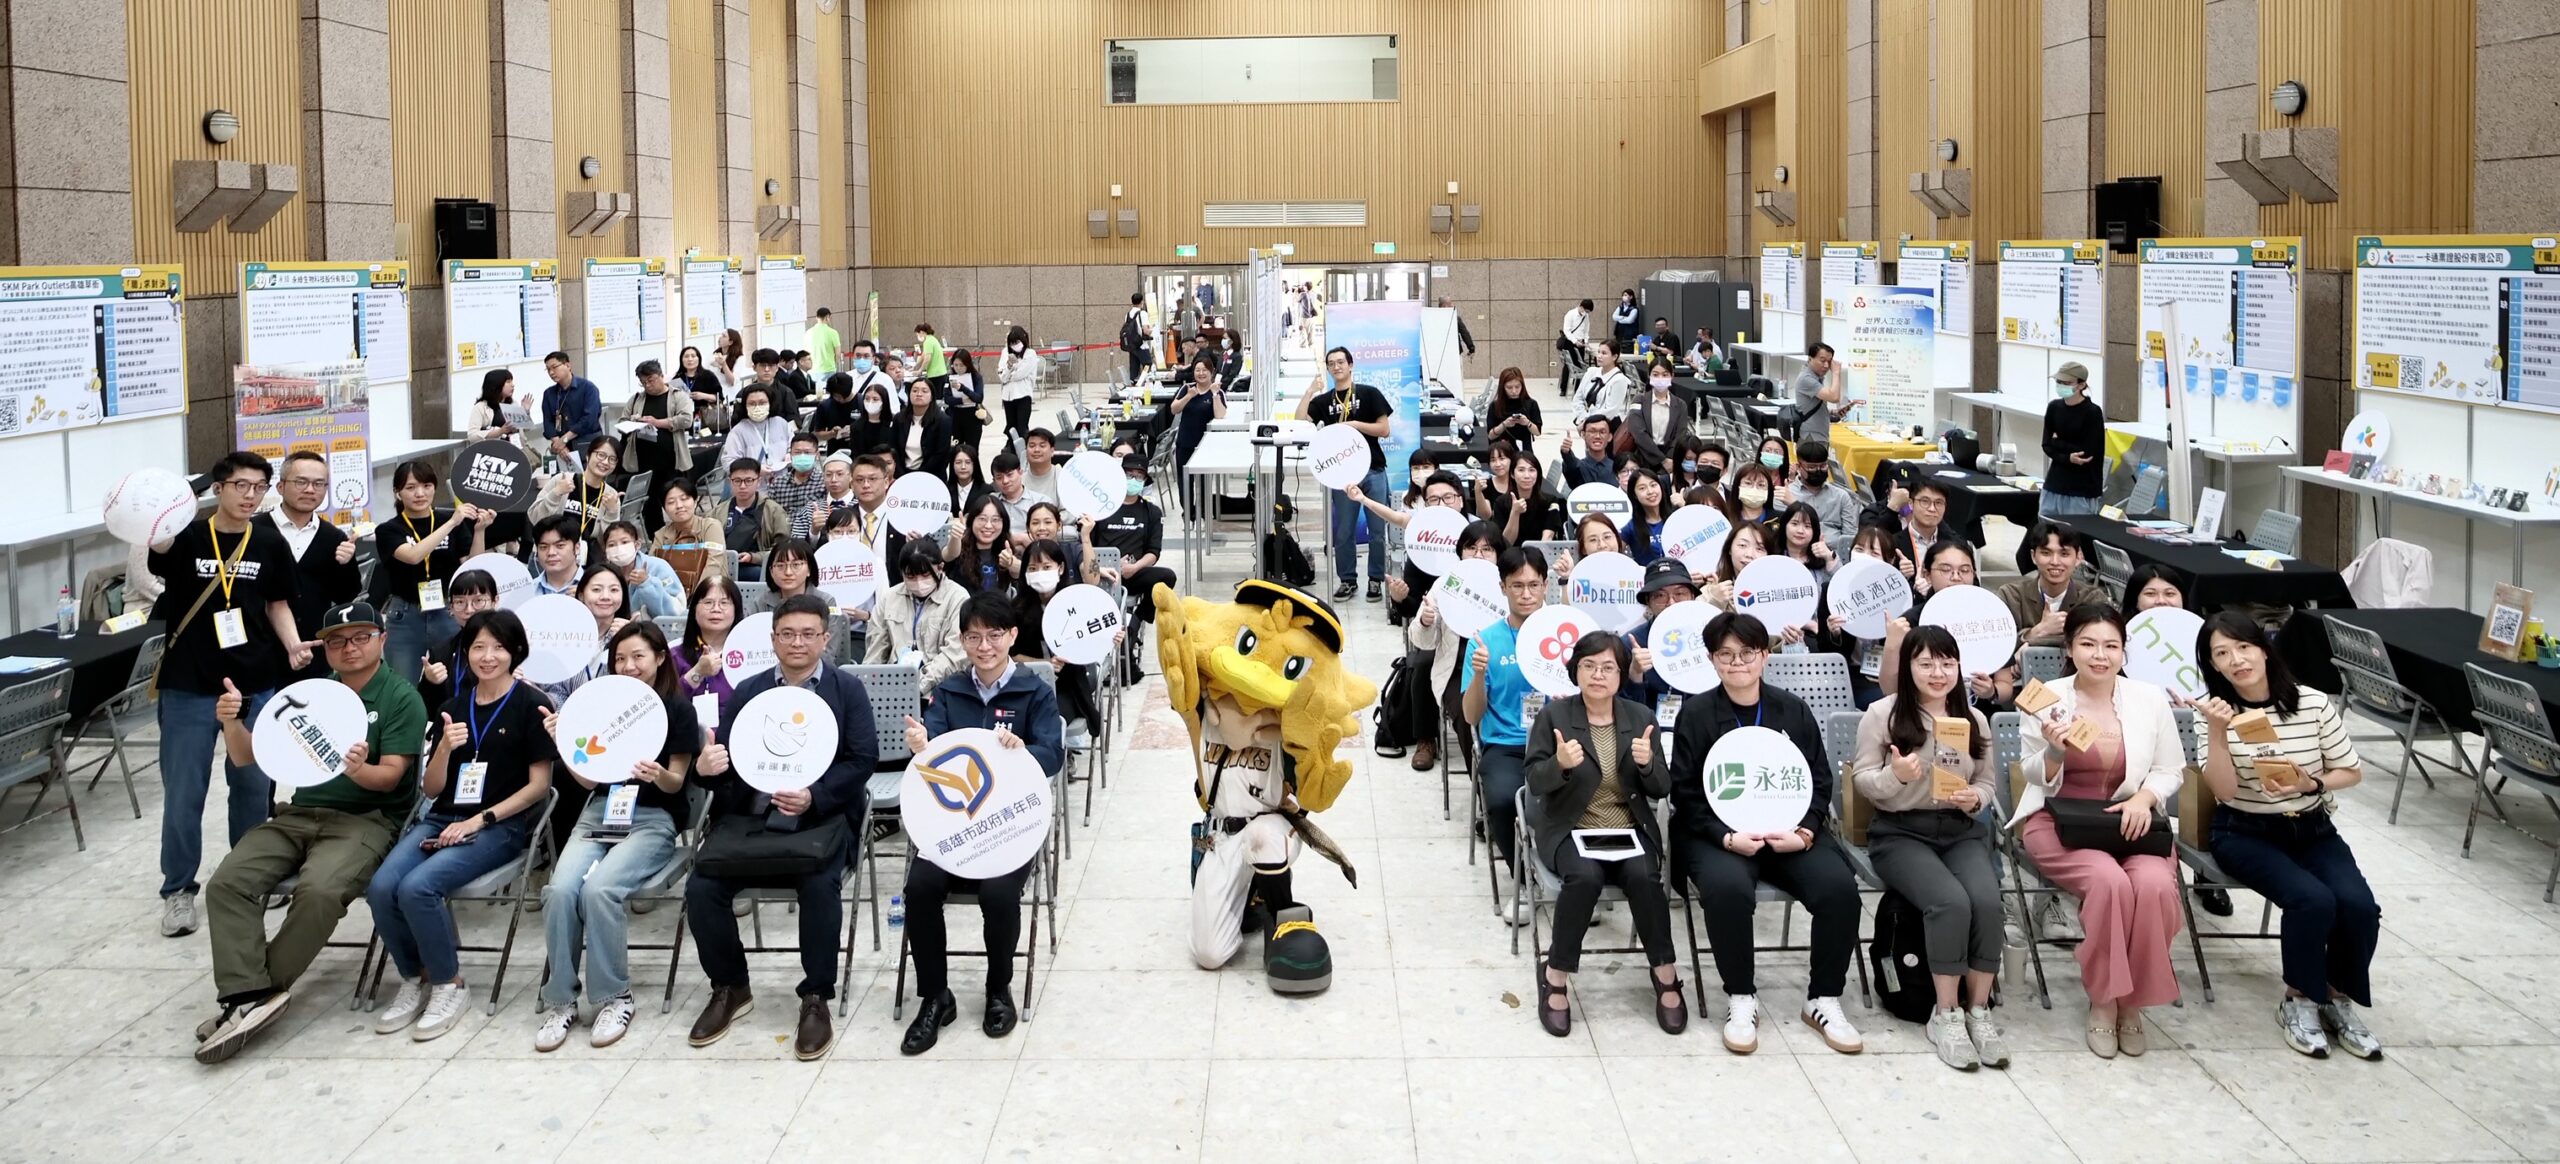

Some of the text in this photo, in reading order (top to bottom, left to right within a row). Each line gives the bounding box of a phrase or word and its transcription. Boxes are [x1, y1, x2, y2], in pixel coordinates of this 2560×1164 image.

[2369, 252, 2376, 262] 3
[2416, 252, 2505, 264] 一卡通票證股份有限公司
[1, 282, 20, 291] SKM
[22, 282, 40, 290] Park
[1354, 338, 1396, 347] FOLLOW
[1364, 348, 1409, 360] CAREERS
[294, 427, 309, 438] WE
[310, 426, 328, 436] ARE
[329, 423, 363, 434] HIRING!
[471, 452, 520, 476] KTV
[1314, 437, 1365, 475] skmpark
[1065, 459, 1116, 514] hourloop
[900, 499, 950, 511] 永慶不動產
[1756, 585, 1815, 604] 台灣福興
[1858, 602, 1881, 617] Urban
[1881, 589, 1908, 605] Resort
[338, 605, 355, 624] T
[1086, 611, 1118, 635] 台鋁
[561, 631, 594, 641] MALL
[288, 714, 342, 773] 台鋼雄鷹
[1753, 765, 1808, 791] 永綠
[612, 808, 628, 816] 代表
[935, 792, 1042, 856] 高雄市政府青年局
[956, 818, 1043, 867] KAOHSIUNG CITY GOVERNMENT
[972, 837, 993, 851] YOUTH
